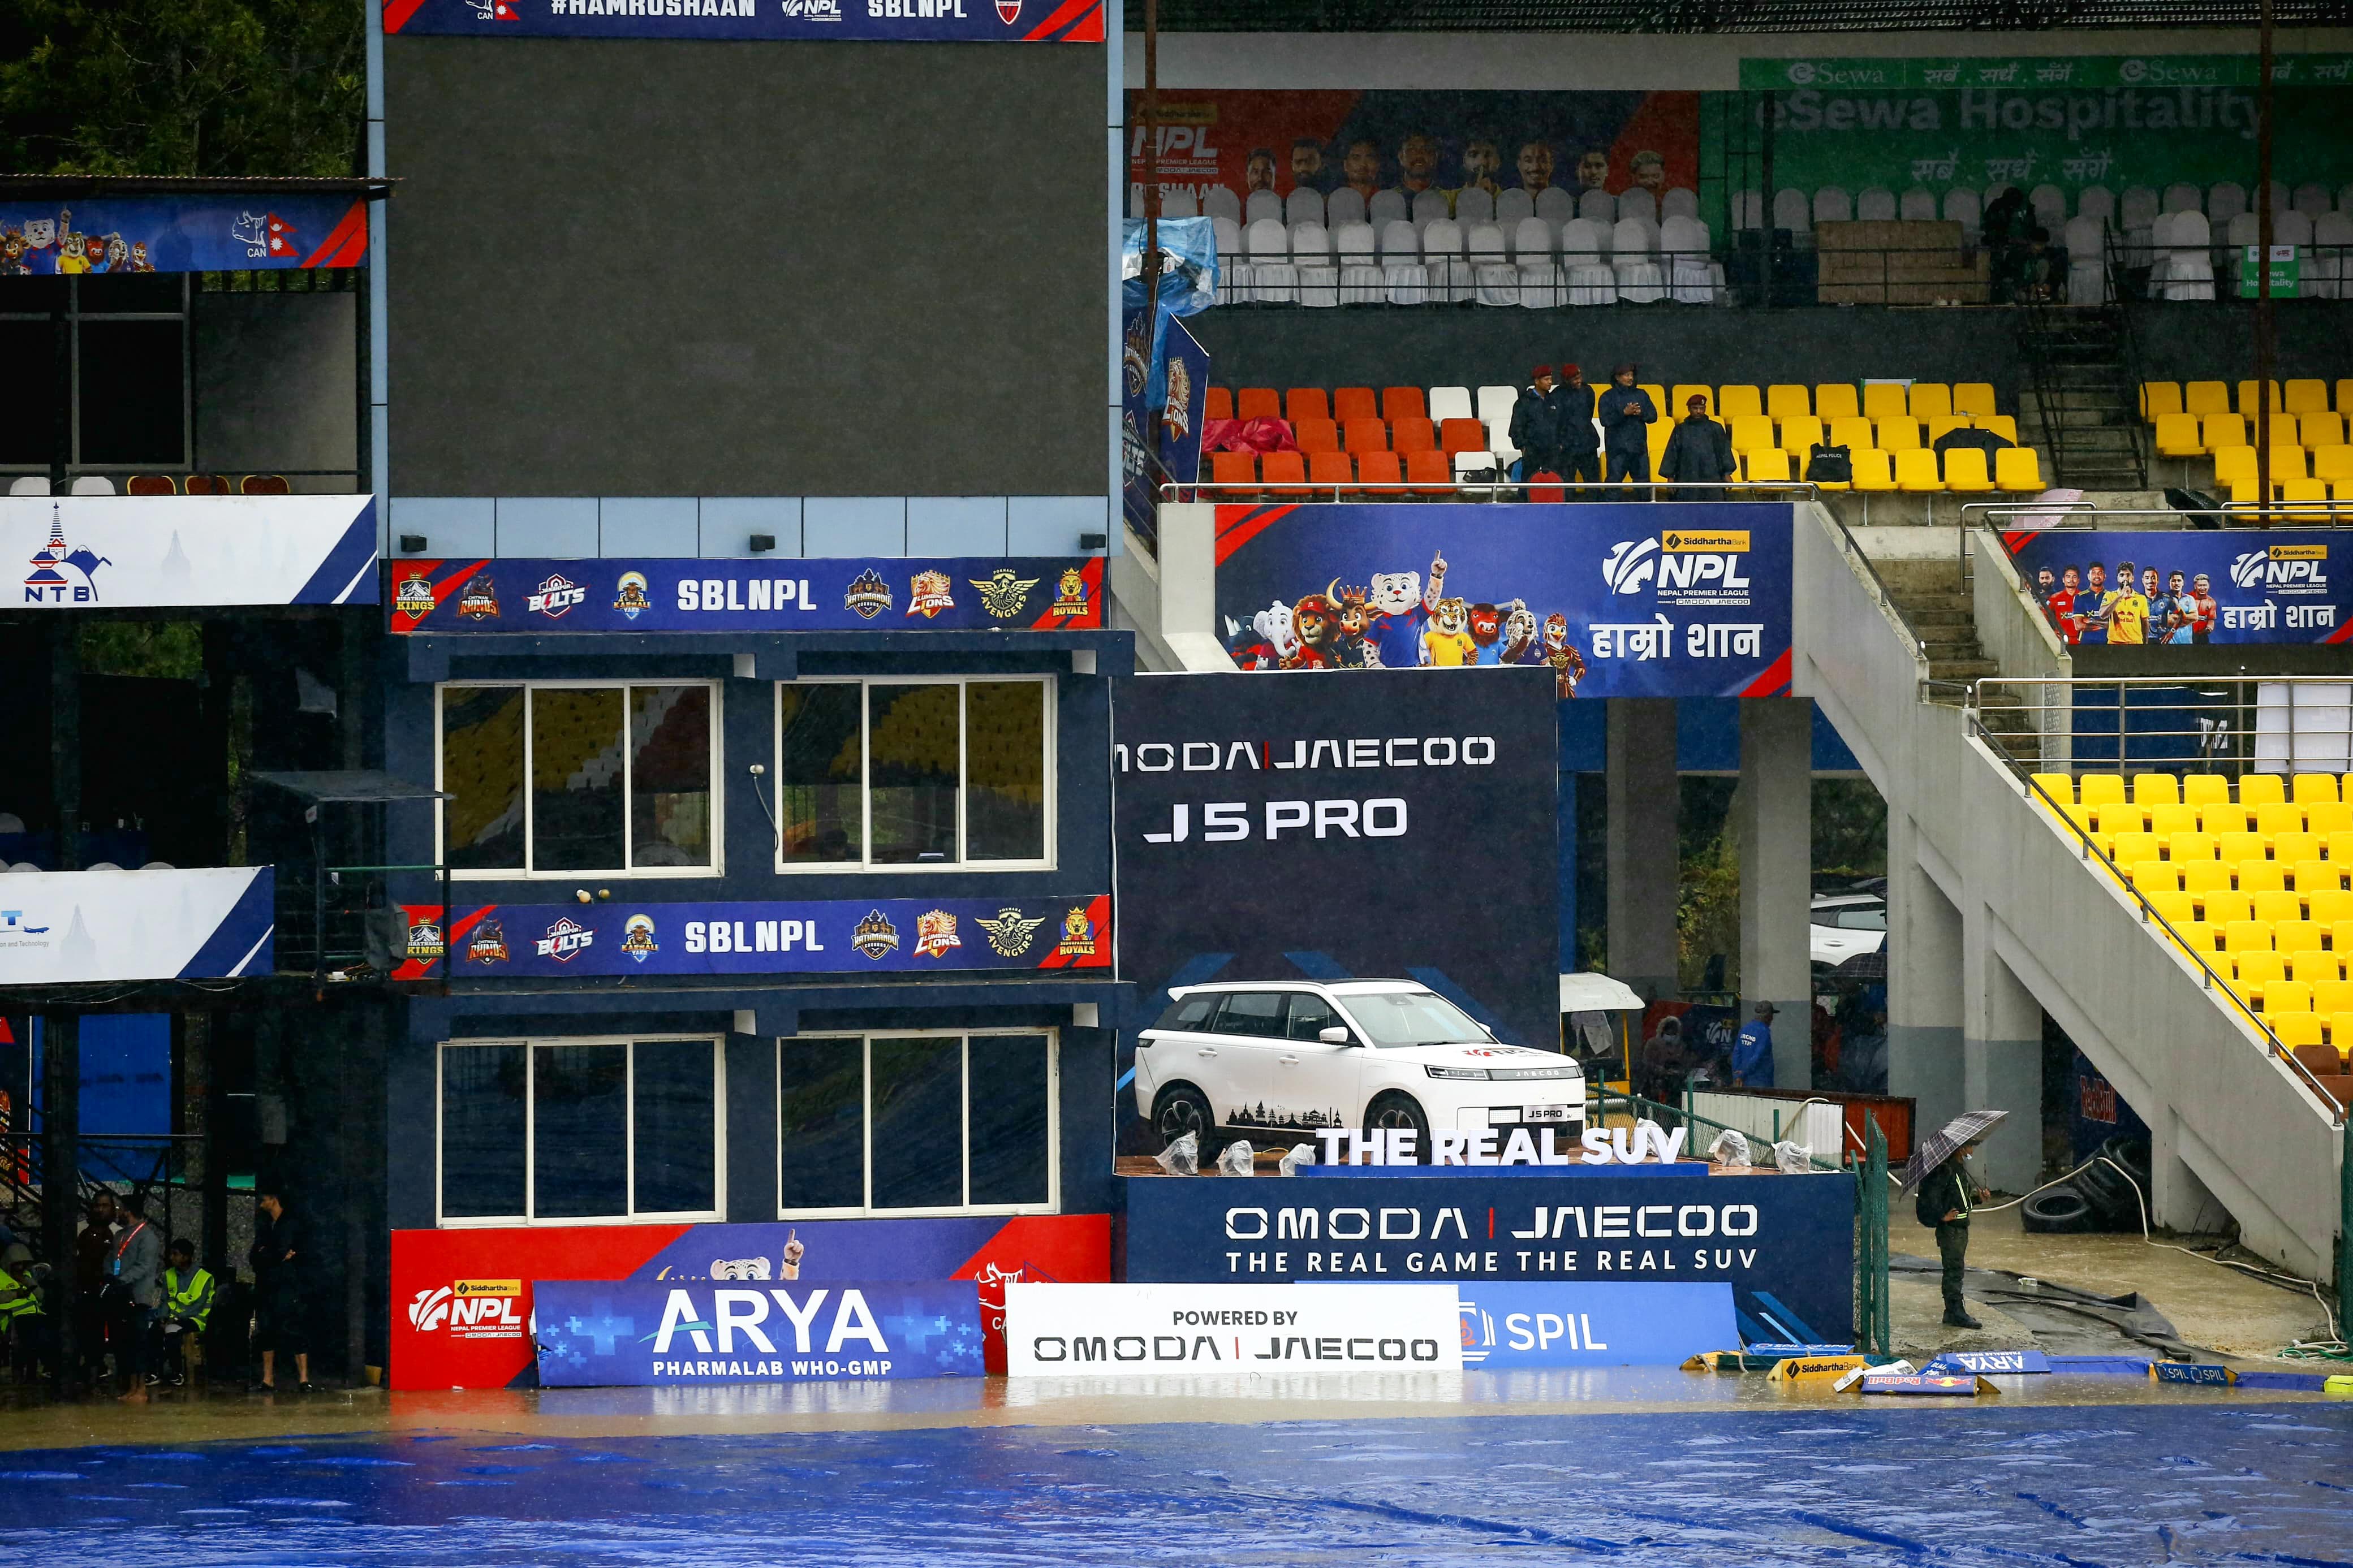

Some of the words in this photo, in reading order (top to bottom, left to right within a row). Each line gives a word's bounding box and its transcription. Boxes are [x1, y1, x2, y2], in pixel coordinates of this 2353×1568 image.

[804, 0, 841, 14] NPL
[868, 0, 967, 18] SBLNPL
[1788, 62, 1884, 84] eSewa
[2120, 59, 2218, 82] eSewa
[1131, 126, 1218, 157] NPL
[247, 248, 266, 258] CAN
[1657, 555, 1750, 588] NPL
[2266, 561, 2326, 583] NPL
[25, 586, 90, 602] NTB
[396, 601, 435, 610] KINGS
[528, 587, 585, 612] BOLTS
[678, 578, 817, 611] SBLNPL
[460, 600, 497, 615] RHINOS
[981, 595, 1027, 618] AVENGERS
[1053, 606, 1088, 616] ROYALS
[2222, 599, 2277, 630] हाम्रो
[2286, 605, 2336, 628] शान
[1589, 612, 1674, 661] हाम्रो
[1687, 623, 1764, 658] शान
[1115, 741, 1260, 773] ODA
[1274, 736, 1496, 769] JAECOO
[1266, 798, 1408, 840] PRO
[537, 931, 593, 956] BOLTS
[685, 920, 824, 953] SBLNPL
[988, 934, 1033, 957] AVENGERS
[469, 944, 506, 959] RHINOS
[1059, 945, 1095, 955] ROYALS
[1316, 1128, 1418, 1166] THE
[1432, 1128, 1569, 1166] REAL
[1581, 1127, 1687, 1165] SUV
[1225, 1206, 1469, 1241] OMODA
[1511, 1204, 1759, 1239] JAECOO
[1227, 1251, 1288, 1273] THE
[1307, 1251, 1387, 1273] REAL
[1407, 1251, 1498, 1273] GAME
[1517, 1250, 1578, 1272] THE
[1597, 1250, 1677, 1272] REAL
[1694, 1249, 1758, 1270] SUV
[450, 1298, 521, 1325] NPL
[652, 1289, 890, 1353] ARYA
[1174, 1311, 1269, 1325] POWERED
[1274, 1311, 1298, 1325] BY
[1505, 1313, 1608, 1351] SPIL
[1034, 1336, 1221, 1361] OMODA
[1254, 1336, 1439, 1361] JAECOO
[653, 1360, 784, 1376] PHARMALAB
[792, 1359, 892, 1376] WHO-GMP
[1958, 1355, 2023, 1370] ARYA
[2168, 1368, 2189, 1380] SPIL
[2203, 1370, 2225, 1380] SPIL
[1895, 1377, 1921, 1385] Red
